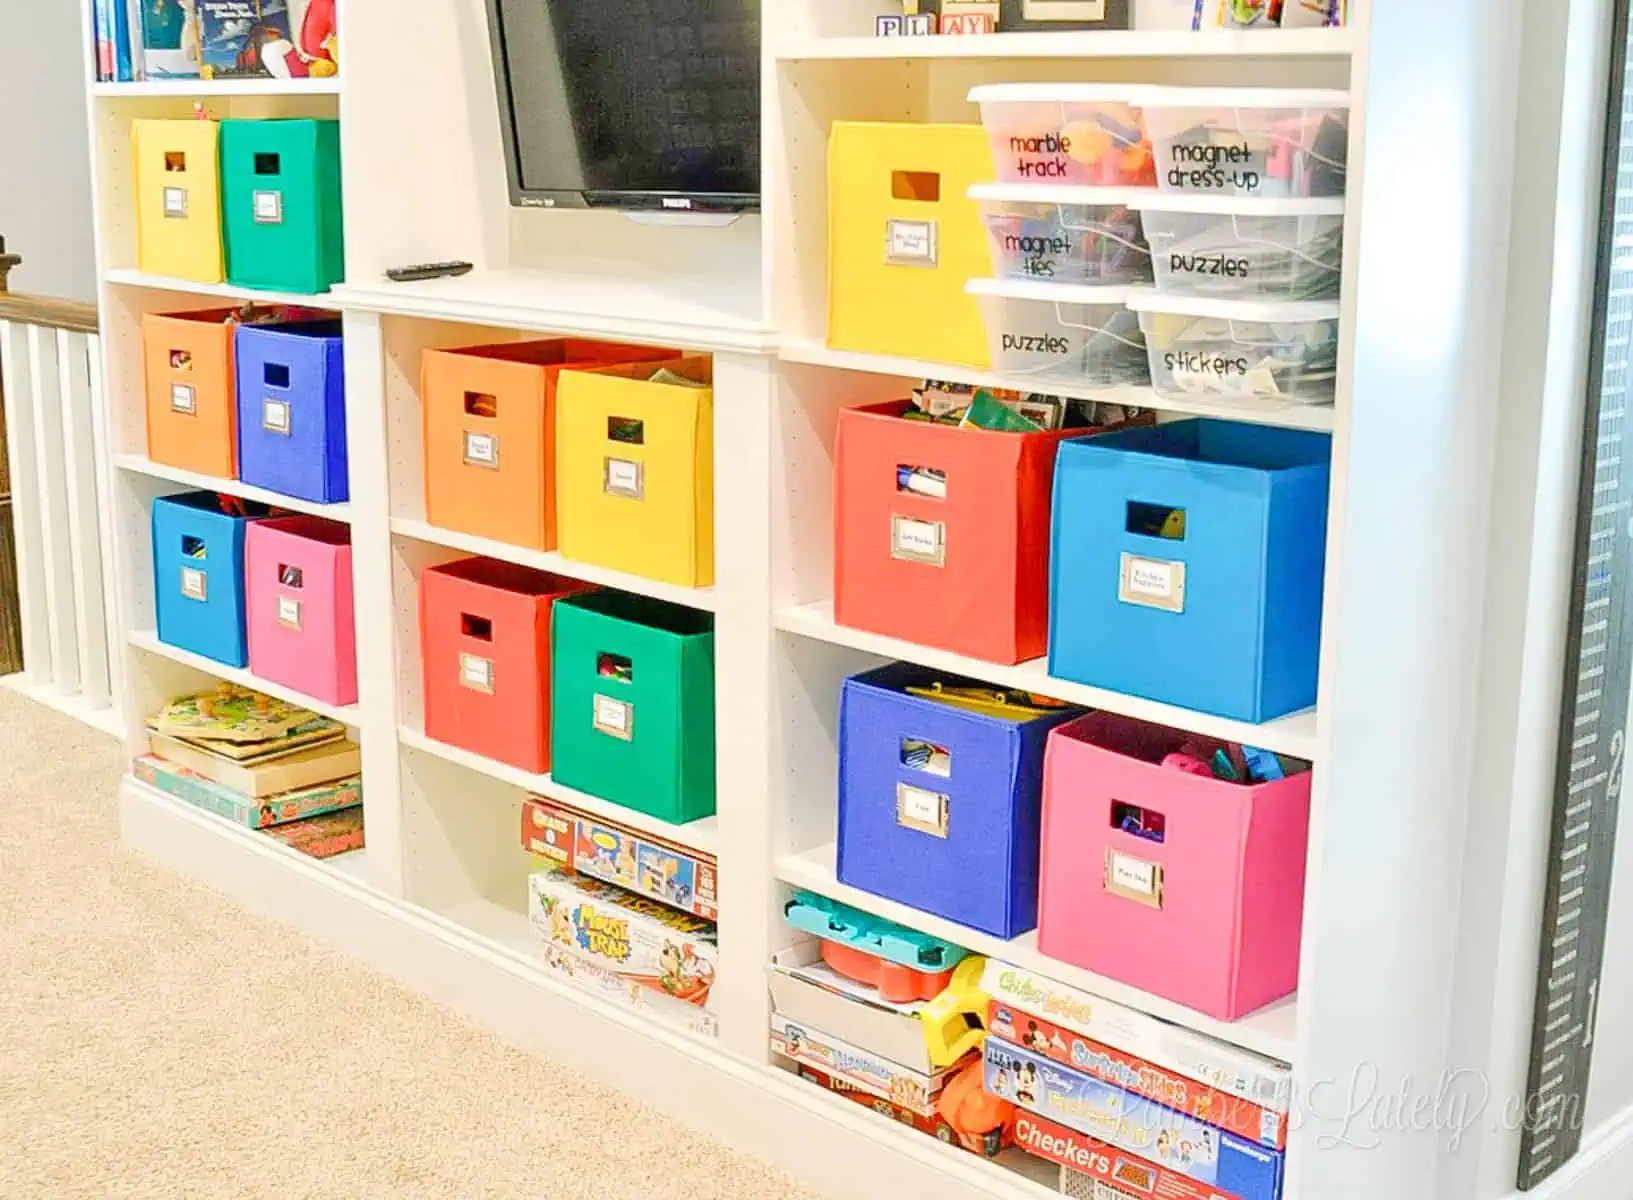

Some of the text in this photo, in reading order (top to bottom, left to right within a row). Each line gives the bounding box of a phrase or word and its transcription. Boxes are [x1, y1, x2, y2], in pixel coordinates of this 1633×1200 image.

[882, 17, 981, 37] PLAY
[1009, 132, 1072, 153] marble
[1171, 140, 1252, 169] magnet
[1016, 156, 1067, 177] track
[1167, 166, 1260, 192] dress-up
[1005, 234, 1072, 260] magnet
[1170, 253, 1249, 278] puzzles
[1001, 331, 1069, 354] puzzles
[1163, 351, 1249, 376] stickers
[1606, 729, 1625, 800] 2
[1582, 978, 1597, 1048] 1
[1014, 1119, 1111, 1174] Checkers
